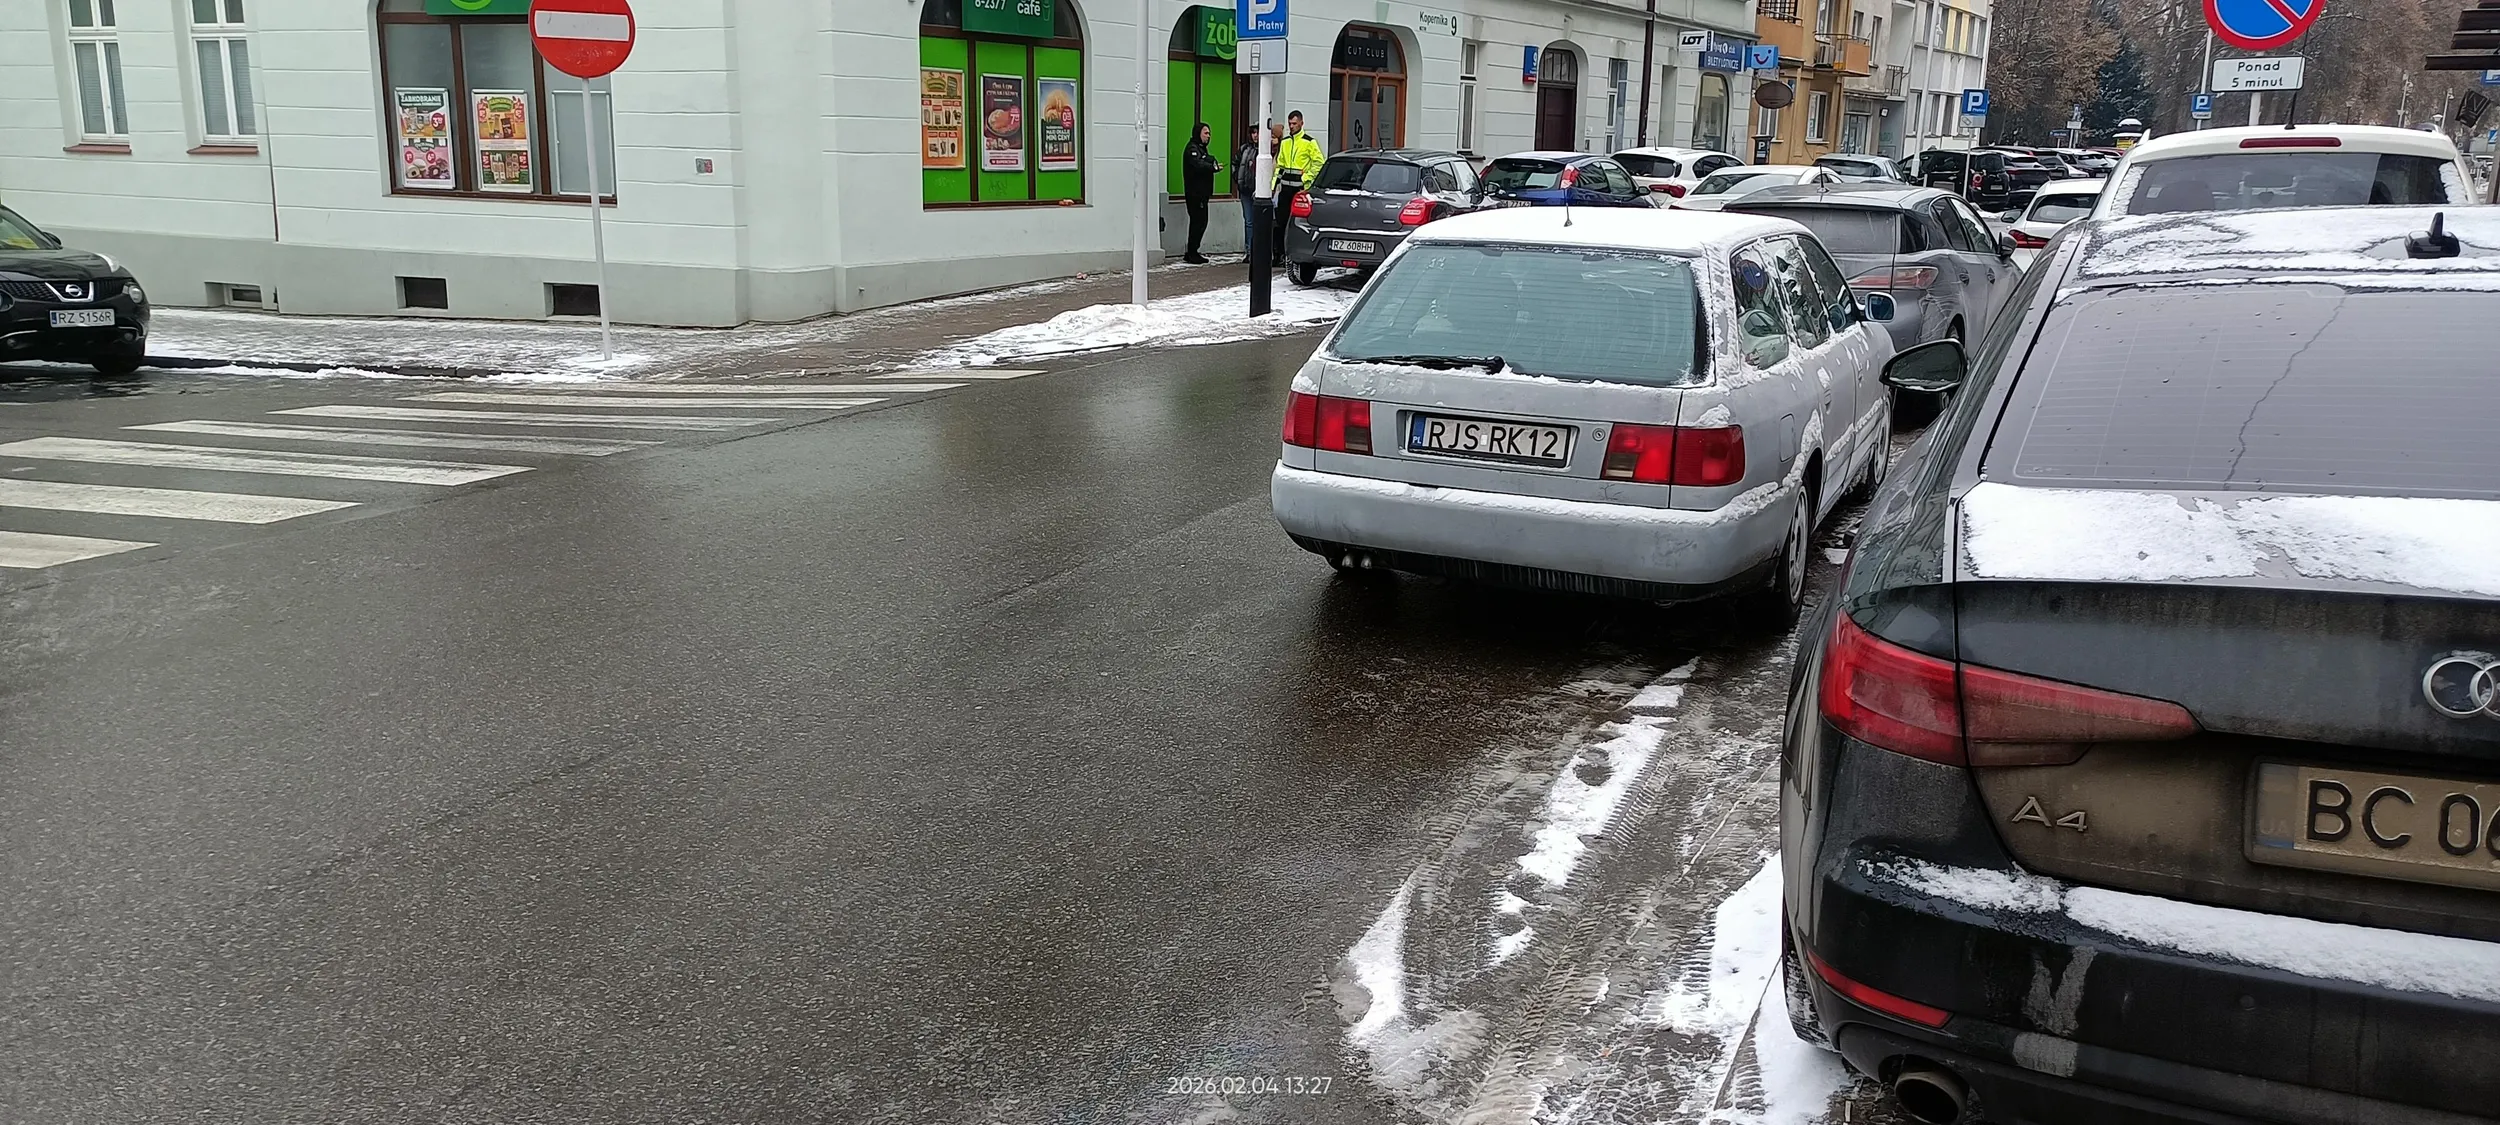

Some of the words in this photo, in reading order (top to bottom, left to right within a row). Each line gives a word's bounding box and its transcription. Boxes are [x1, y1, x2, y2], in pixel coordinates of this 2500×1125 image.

[1017, 0, 1040, 16] café
[1248, 0, 1276, 30] P
[1257, 21, 1284, 32] Płatny
[1419, 11, 1448, 26] Kopernika
[1451, 16, 1457, 36] 9
[1206, 14, 1236, 47] żab
[1681, 36, 1705, 45] LOT
[1347, 46, 1362, 55] CUT
[1366, 48, 1385, 58] CLUB
[2237, 60, 2280, 72] Ponad
[2231, 77, 2239, 88] 5
[2245, 77, 2283, 87] minut
[1967, 91, 1984, 111] P
[2195, 95, 2209, 109] P
[1758, 141, 1766, 150] P
[1333, 241, 1345, 250] RZ
[1347, 242, 1373, 252] 608HH
[58, 312, 76, 324] RZ
[79, 311, 112, 323] 5156R
[1412, 436, 1422, 445] PL
[1428, 421, 1481, 450] RJS
[1488, 425, 1559, 458] RK12
[2012, 795, 2088, 832] A4
[2306, 778, 2416, 850] BC
